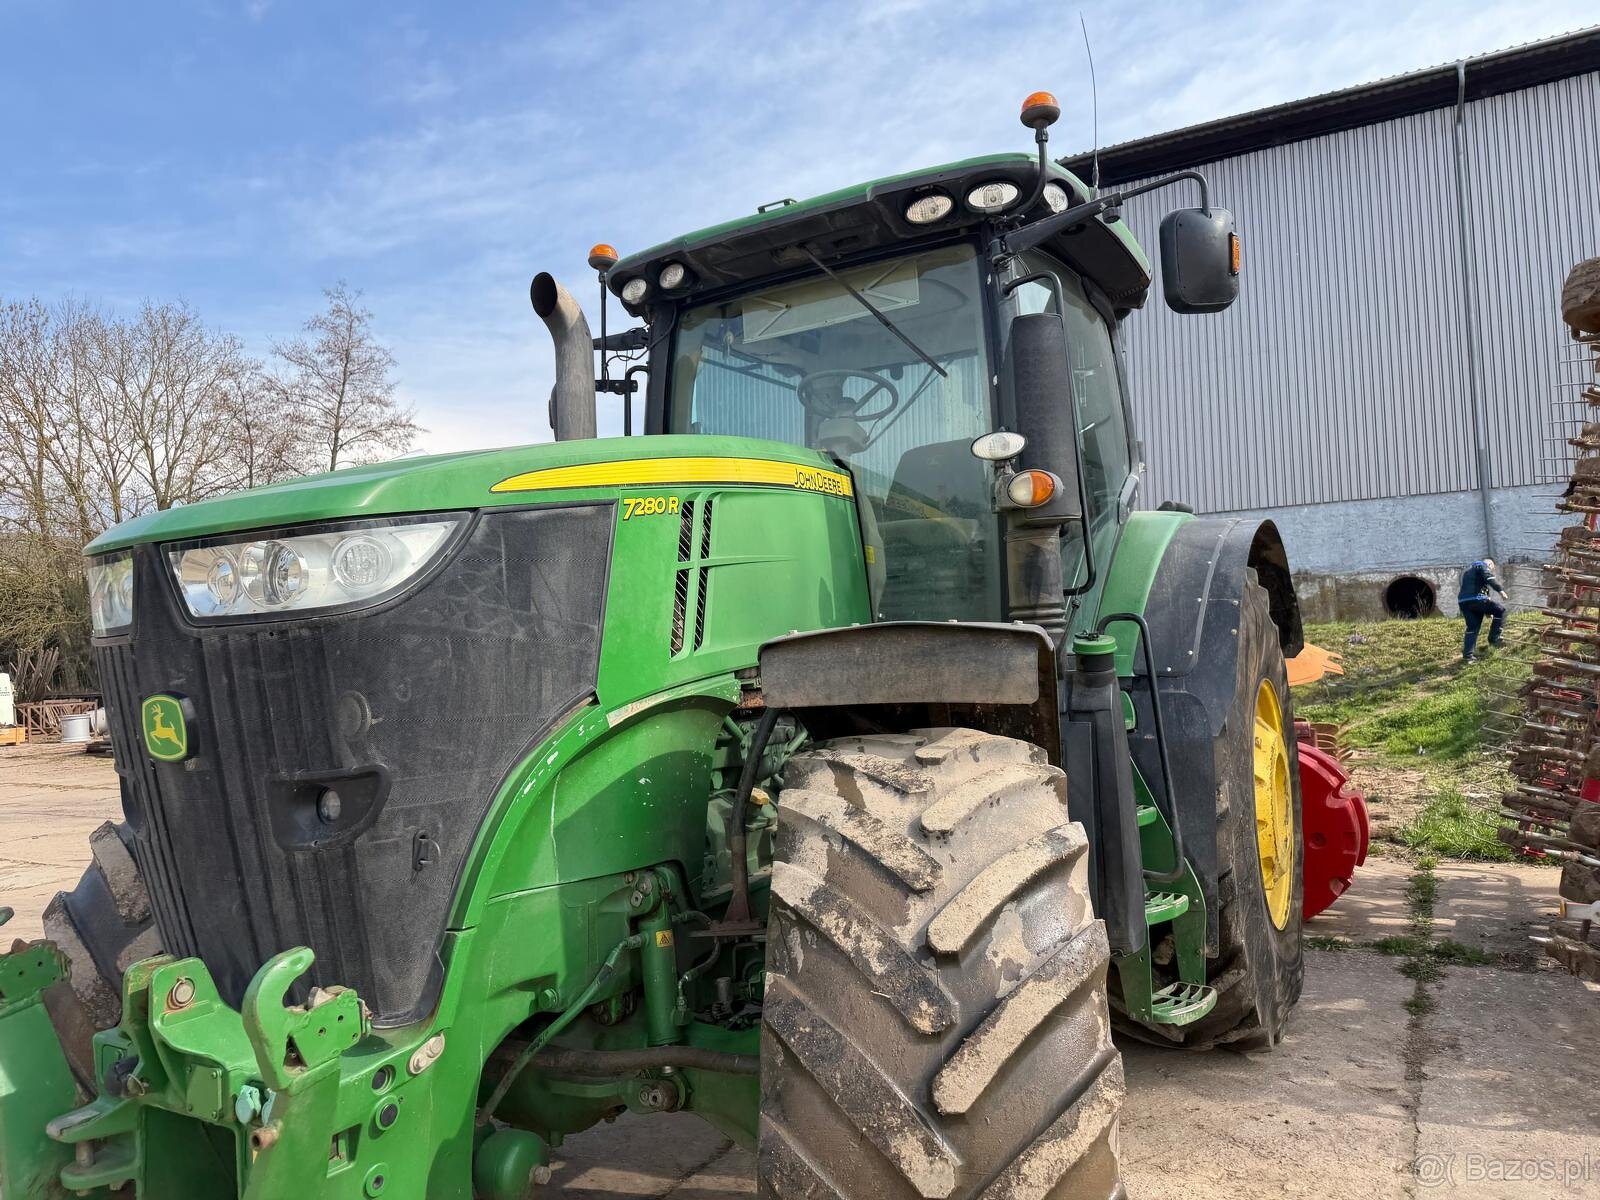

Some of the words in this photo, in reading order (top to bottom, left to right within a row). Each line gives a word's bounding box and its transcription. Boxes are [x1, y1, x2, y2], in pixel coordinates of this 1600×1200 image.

[794, 468, 817, 490] JOHN
[816, 472, 843, 495] DEERE
[623, 497, 666, 521] 7280
[668, 496, 679, 514] R
